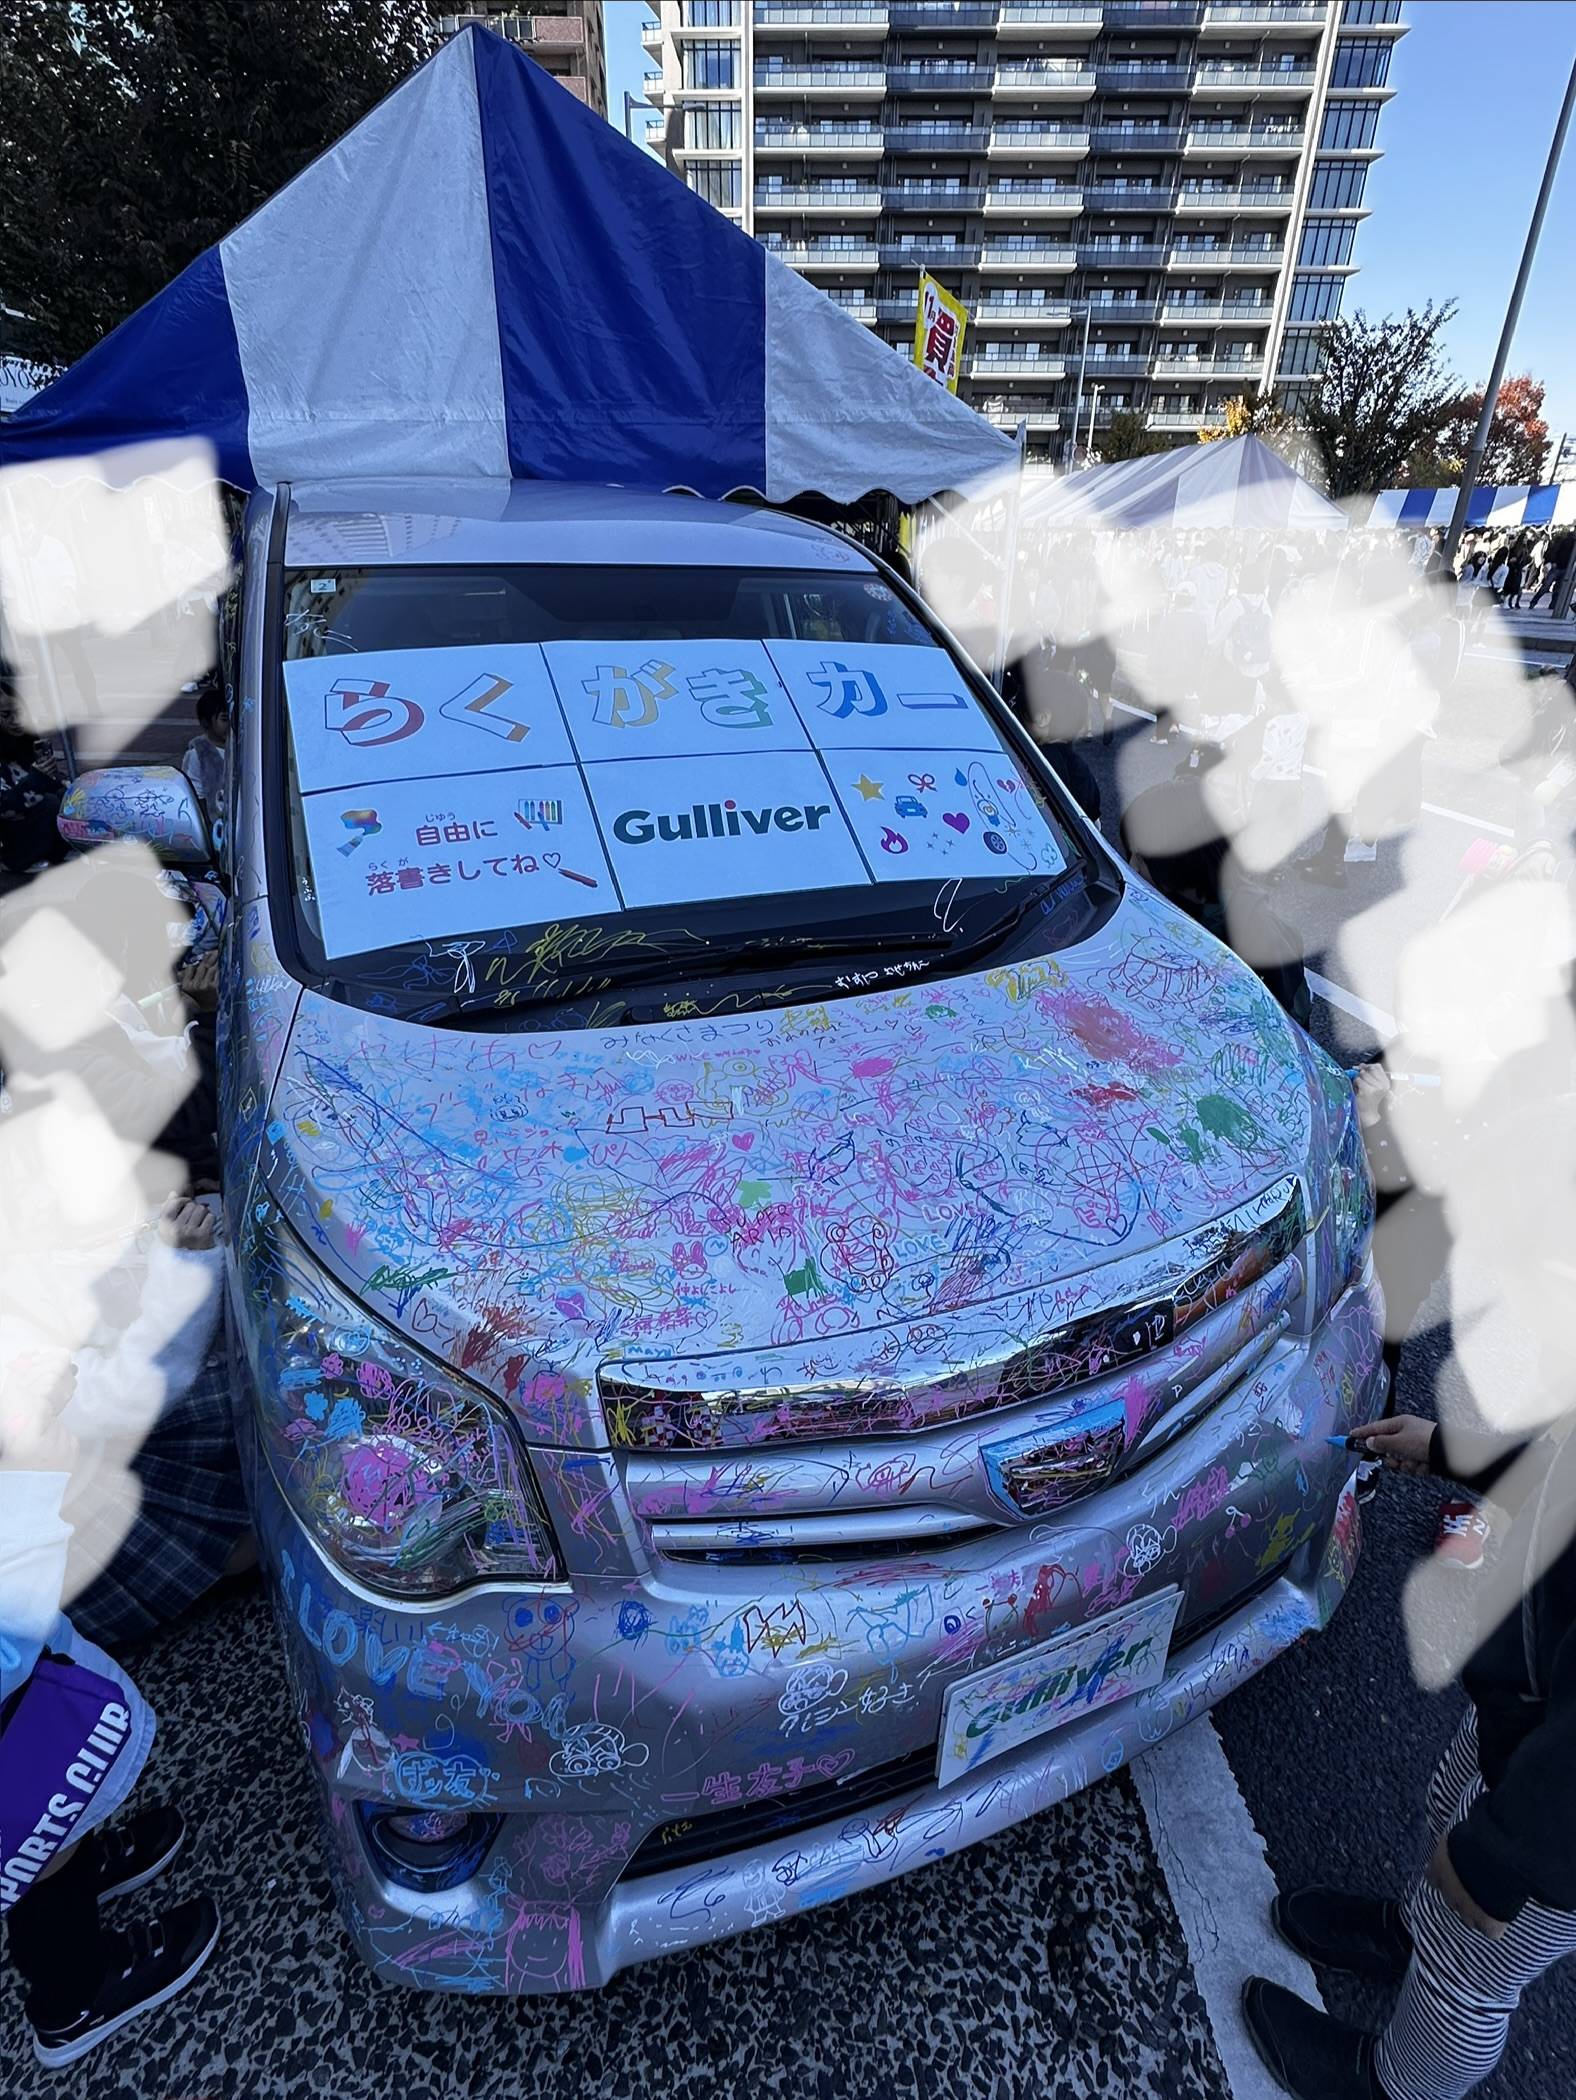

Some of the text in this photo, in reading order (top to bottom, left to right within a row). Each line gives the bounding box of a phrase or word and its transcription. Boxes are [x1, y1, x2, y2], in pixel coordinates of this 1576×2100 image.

[415, 818, 499, 847] 自由に
[613, 799, 831, 845] Gulliver
[364, 853, 541, 896] 落書きしてね
[300, 1582, 449, 1699] LOVE
[0, 1793, 86, 1911] PORTS
